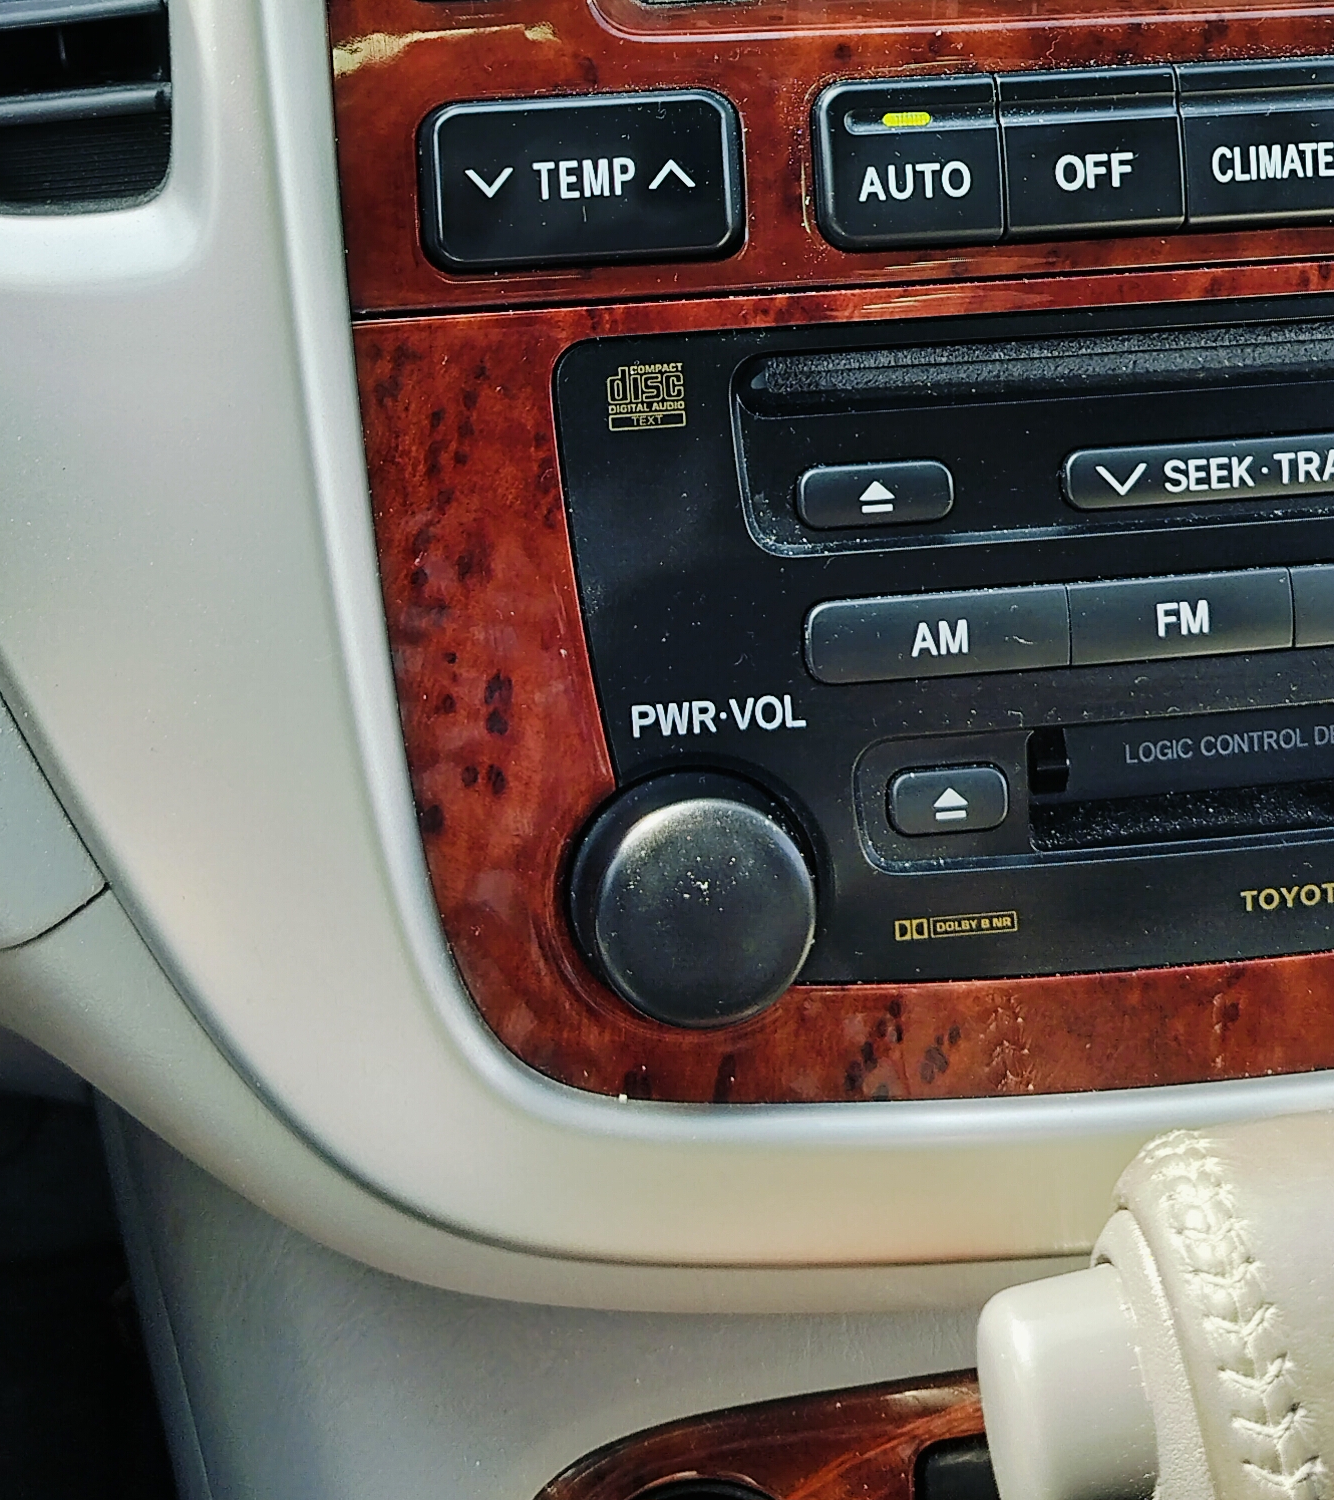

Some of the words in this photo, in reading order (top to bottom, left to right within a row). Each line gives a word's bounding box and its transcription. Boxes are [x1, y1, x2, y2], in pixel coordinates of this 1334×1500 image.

[533, 156, 637, 201] TEMP
[858, 160, 972, 202] AUTO
[1054, 151, 1134, 192] OFF
[607, 366, 684, 404] disc
[629, 362, 683, 375] COMPACT
[608, 403, 649, 414] DIGITAL
[652, 400, 686, 411] AUDIO
[631, 414, 664, 426] TEXT
[1155, 599, 1210, 637] FM
[910, 619, 970, 658] AM
[1124, 737, 1194, 765] LOGIC
[1199, 727, 1309, 757] CONTROL
[935, 918, 978, 933] DOLBY
[992, 915, 1013, 928] NR
